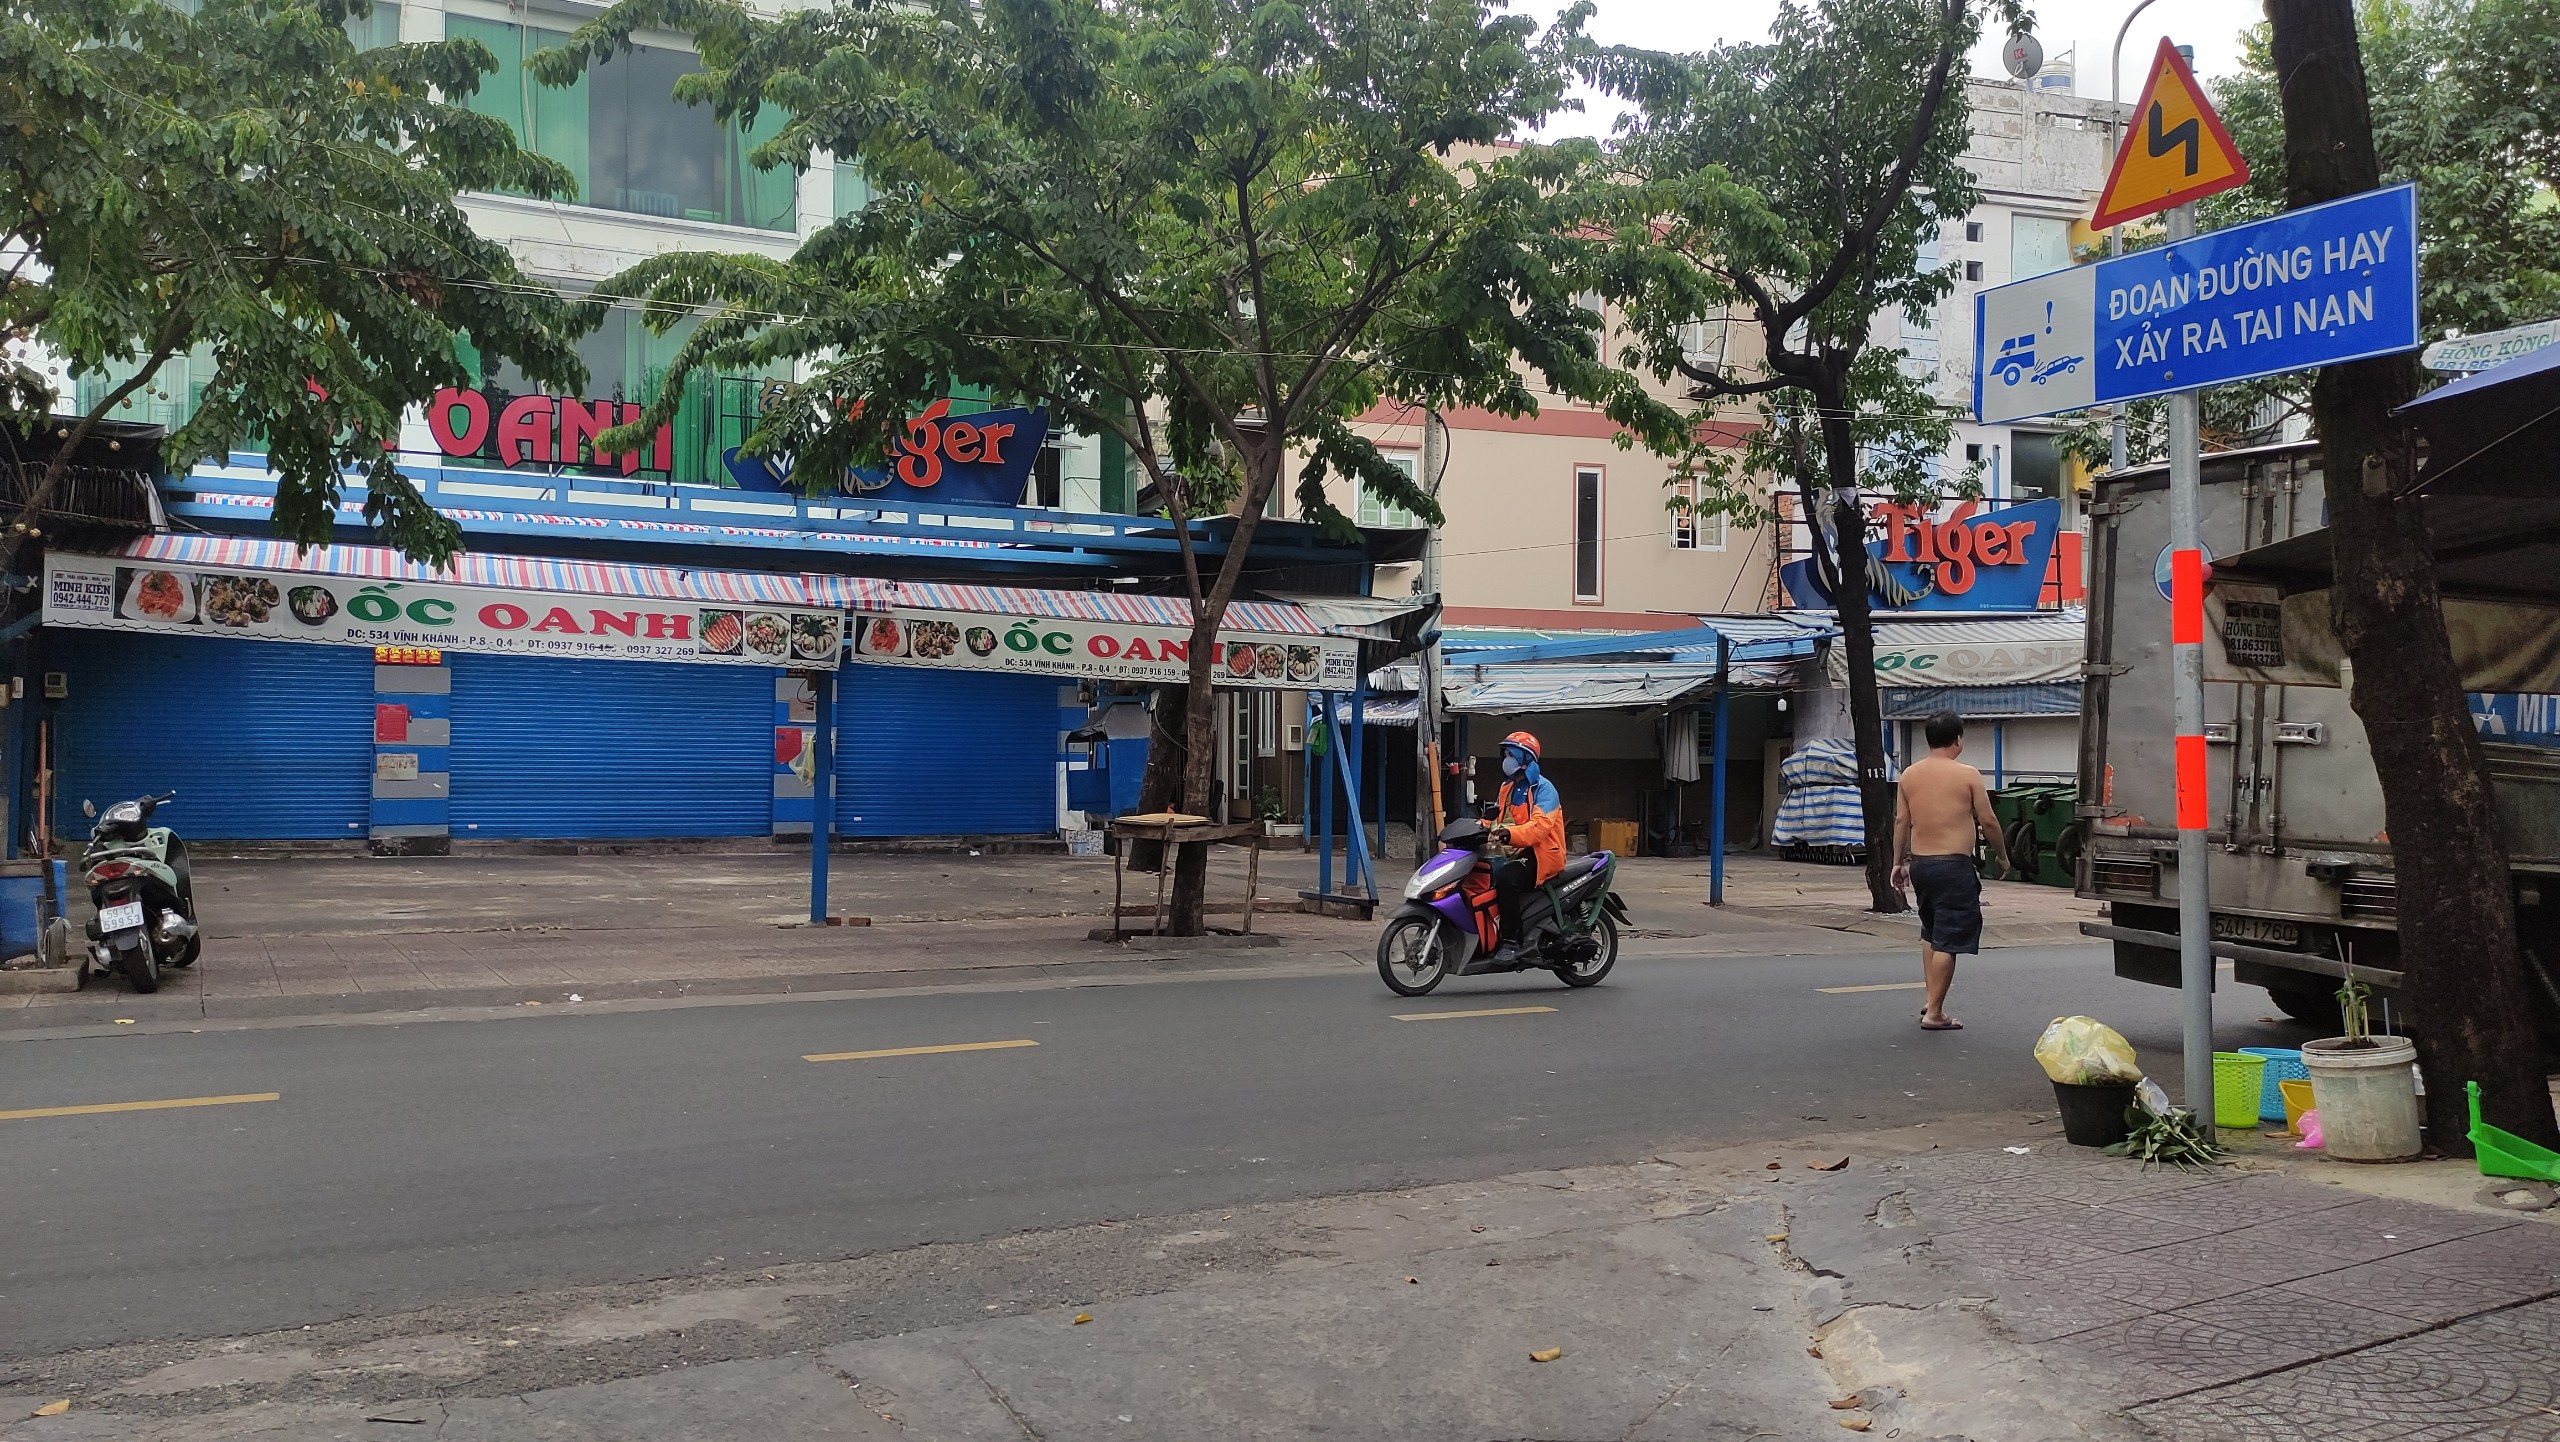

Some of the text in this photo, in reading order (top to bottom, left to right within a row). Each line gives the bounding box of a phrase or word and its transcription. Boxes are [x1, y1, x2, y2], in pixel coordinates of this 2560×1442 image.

[2109, 226, 2393, 319] ĐOẠN ĐƯỜNG HAY
[2114, 285, 2373, 370] XẢY RA TAI NẠN
[2497, 335, 2550, 356] KÔNG
[1871, 494, 2037, 595] Tiger
[53, 581, 83, 593] MINH
[53, 592, 110, 607] 0942.444.779
[347, 583, 694, 641] ỐC OANH
[347, 629, 366, 639] ĐC:
[369, 630, 389, 640] 534
[393, 629, 418, 642] VĨNH
[422, 631, 459, 644] KHÁNH
[469, 636, 486, 646] P.8
[496, 638, 513, 647] Q.4
[528, 639, 545, 648] ĐT:
[548, 640, 572, 650] 0937
[576, 642, 595, 651] 916
[627, 645, 651, 654] 0937
[655, 646, 672, 655] 327
[676, 647, 694, 656] 269
[1003, 618, 1074, 656] ỐC
[1005, 658, 1018, 666] ĐC:
[1019, 659, 1032, 668] 534
[1052, 661, 1075, 670] KHÁNH
[1098, 664, 1110, 673] Q.4
[1131, 666, 1148, 675] 0937
[1149, 668, 1162, 676] 916
[1163, 668, 1176, 676] 159
[1213, 671, 1225, 679] 269
[1873, 649, 1939, 671] ỐC
